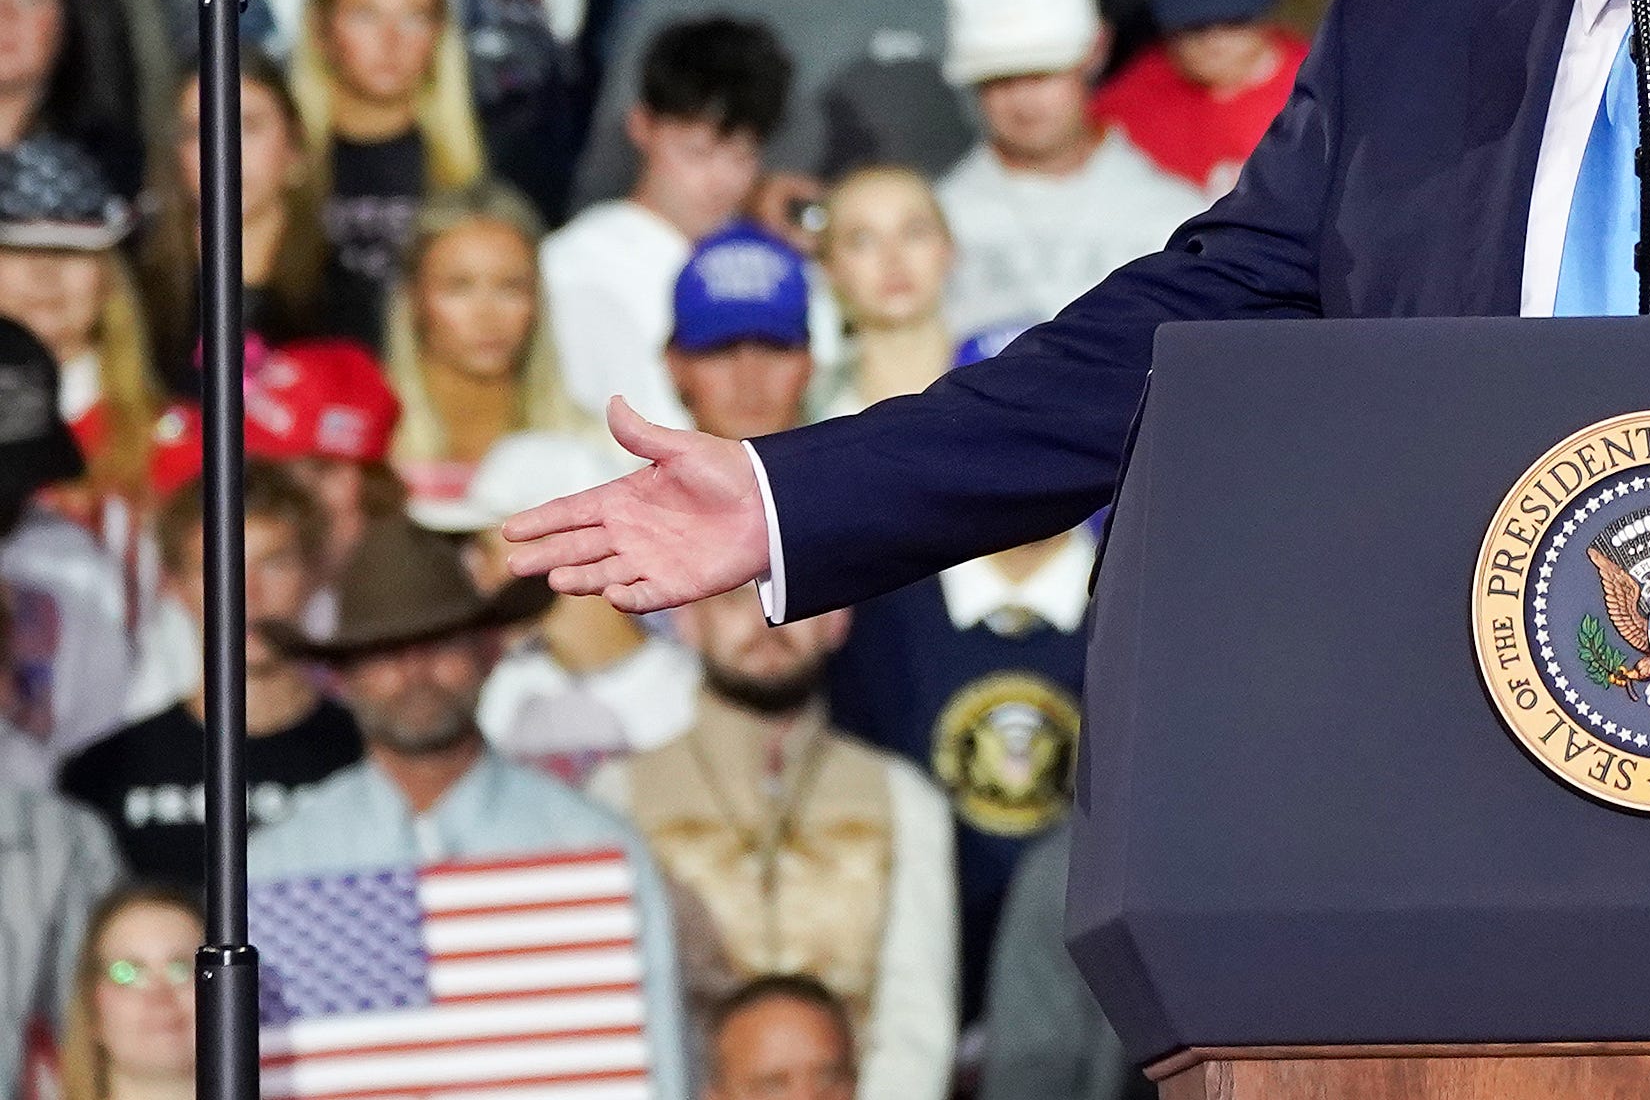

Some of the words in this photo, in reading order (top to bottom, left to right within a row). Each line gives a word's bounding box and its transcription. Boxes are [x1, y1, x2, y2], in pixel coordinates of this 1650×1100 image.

[1492, 616, 1521, 670] THE
[1507, 678, 1538, 710] OF
[1538, 710, 1638, 791] SEAL
